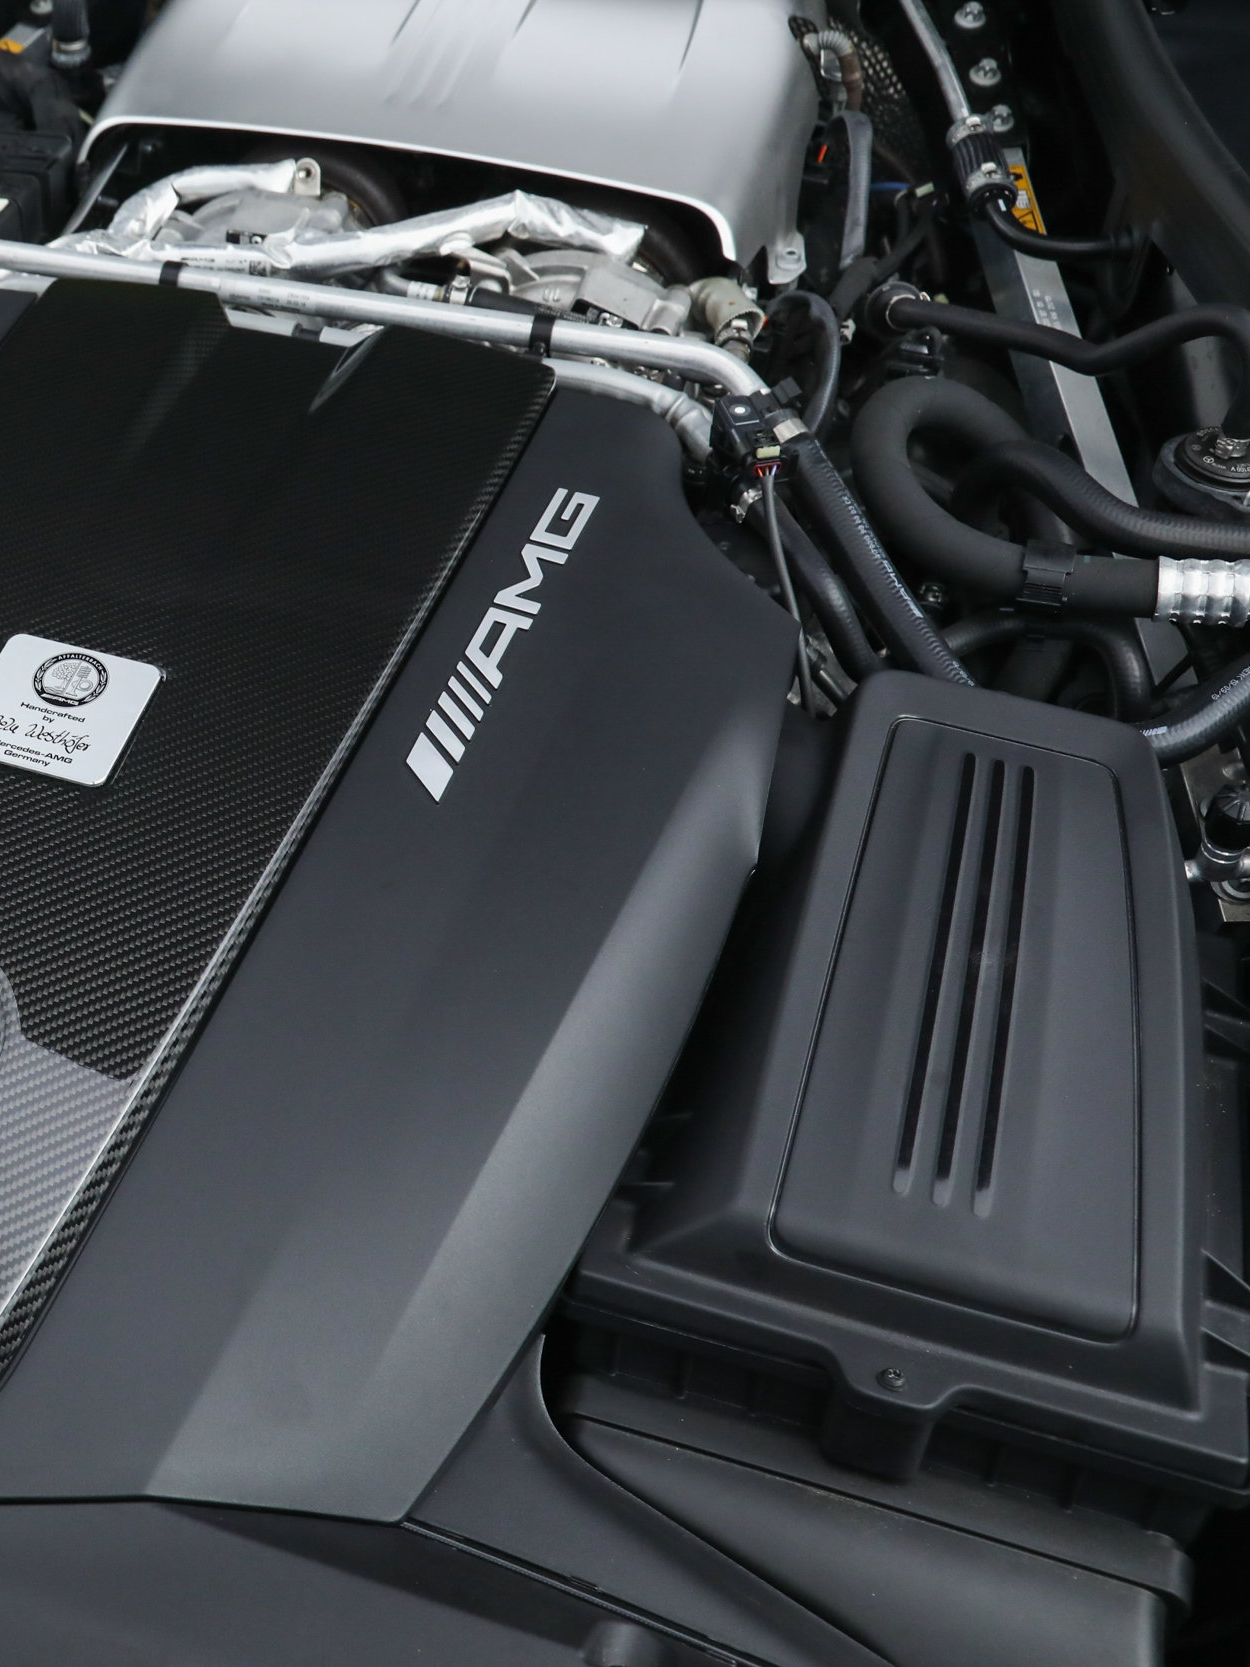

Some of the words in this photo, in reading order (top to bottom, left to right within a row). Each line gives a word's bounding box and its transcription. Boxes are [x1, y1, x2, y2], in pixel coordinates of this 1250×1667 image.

[58, 654, 104, 671] AFFALTERBACH
[20, 701, 86, 724] Handcrafted
[42, 715, 55, 724] by
[3, 749, 51, 767] Germany
